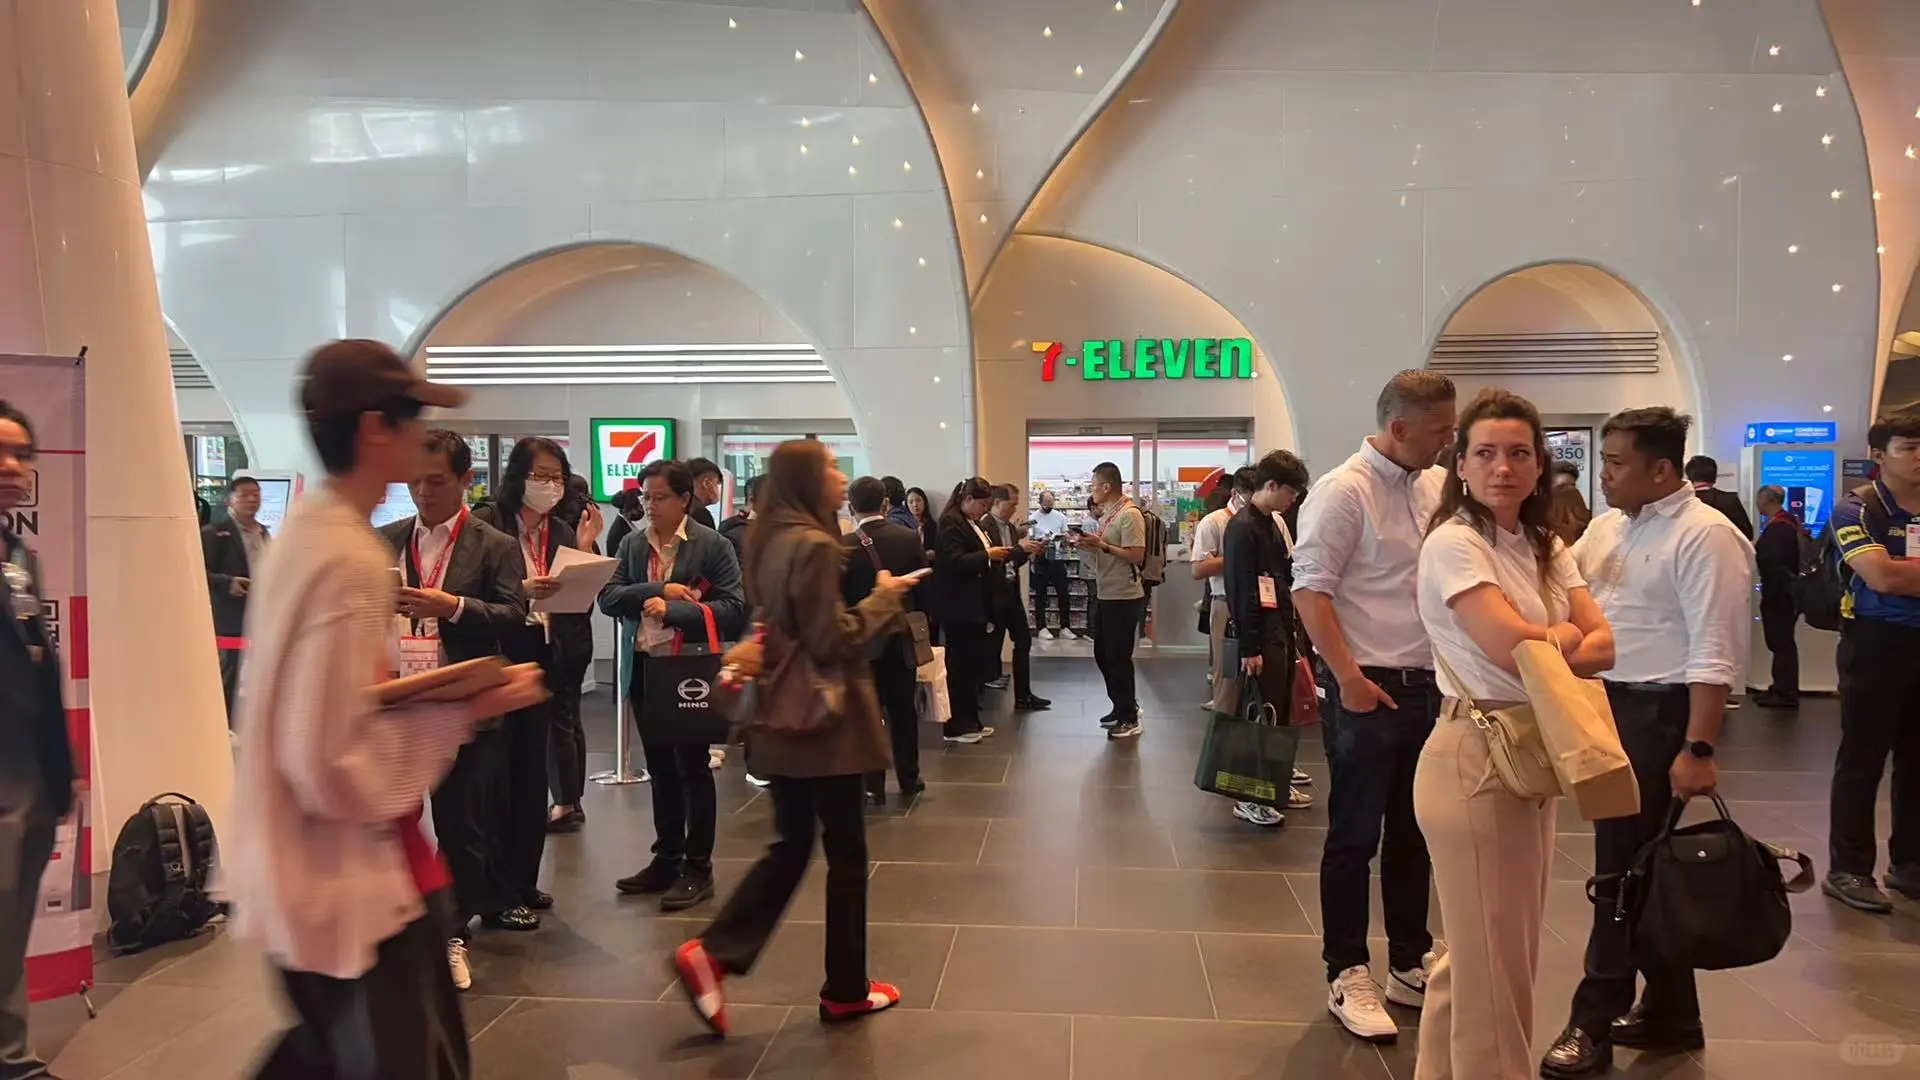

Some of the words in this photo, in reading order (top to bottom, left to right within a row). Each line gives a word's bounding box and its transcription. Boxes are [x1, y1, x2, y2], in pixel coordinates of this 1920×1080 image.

[1555, 447, 1584, 460] 350
[606, 463, 647, 477] ELEV
[678, 701, 709, 709] HINO
